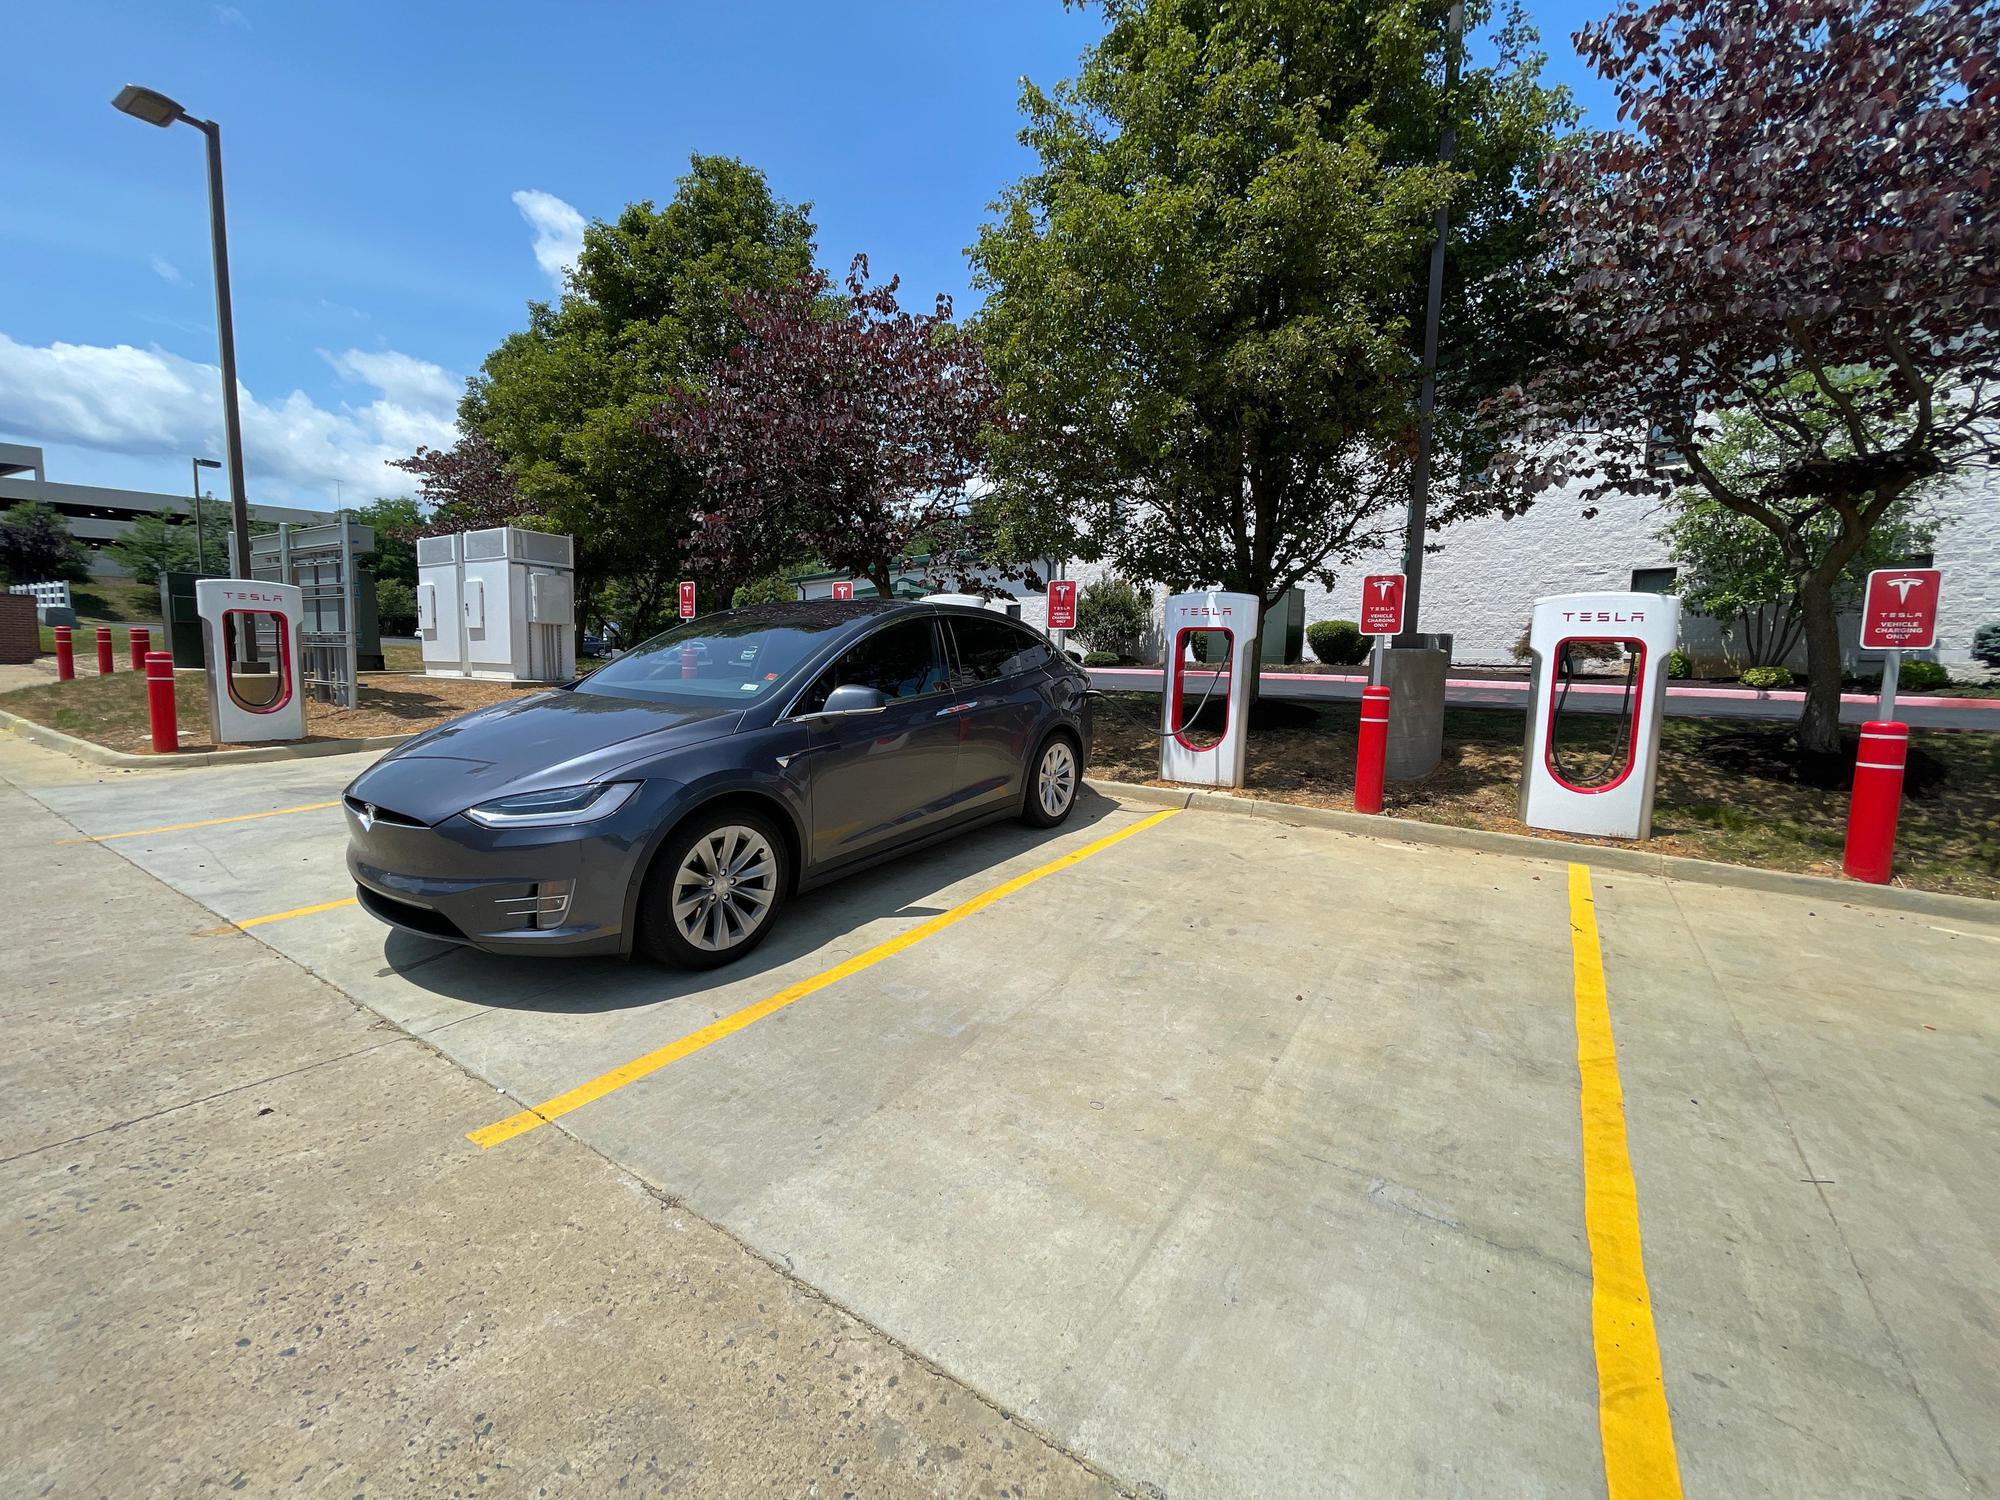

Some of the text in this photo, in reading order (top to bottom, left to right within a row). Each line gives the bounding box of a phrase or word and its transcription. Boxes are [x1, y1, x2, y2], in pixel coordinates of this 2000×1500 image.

[223, 591, 284, 602] TESLA
[1180, 607, 1232, 616] TESLA
[1562, 612, 1645, 622] TESLA
